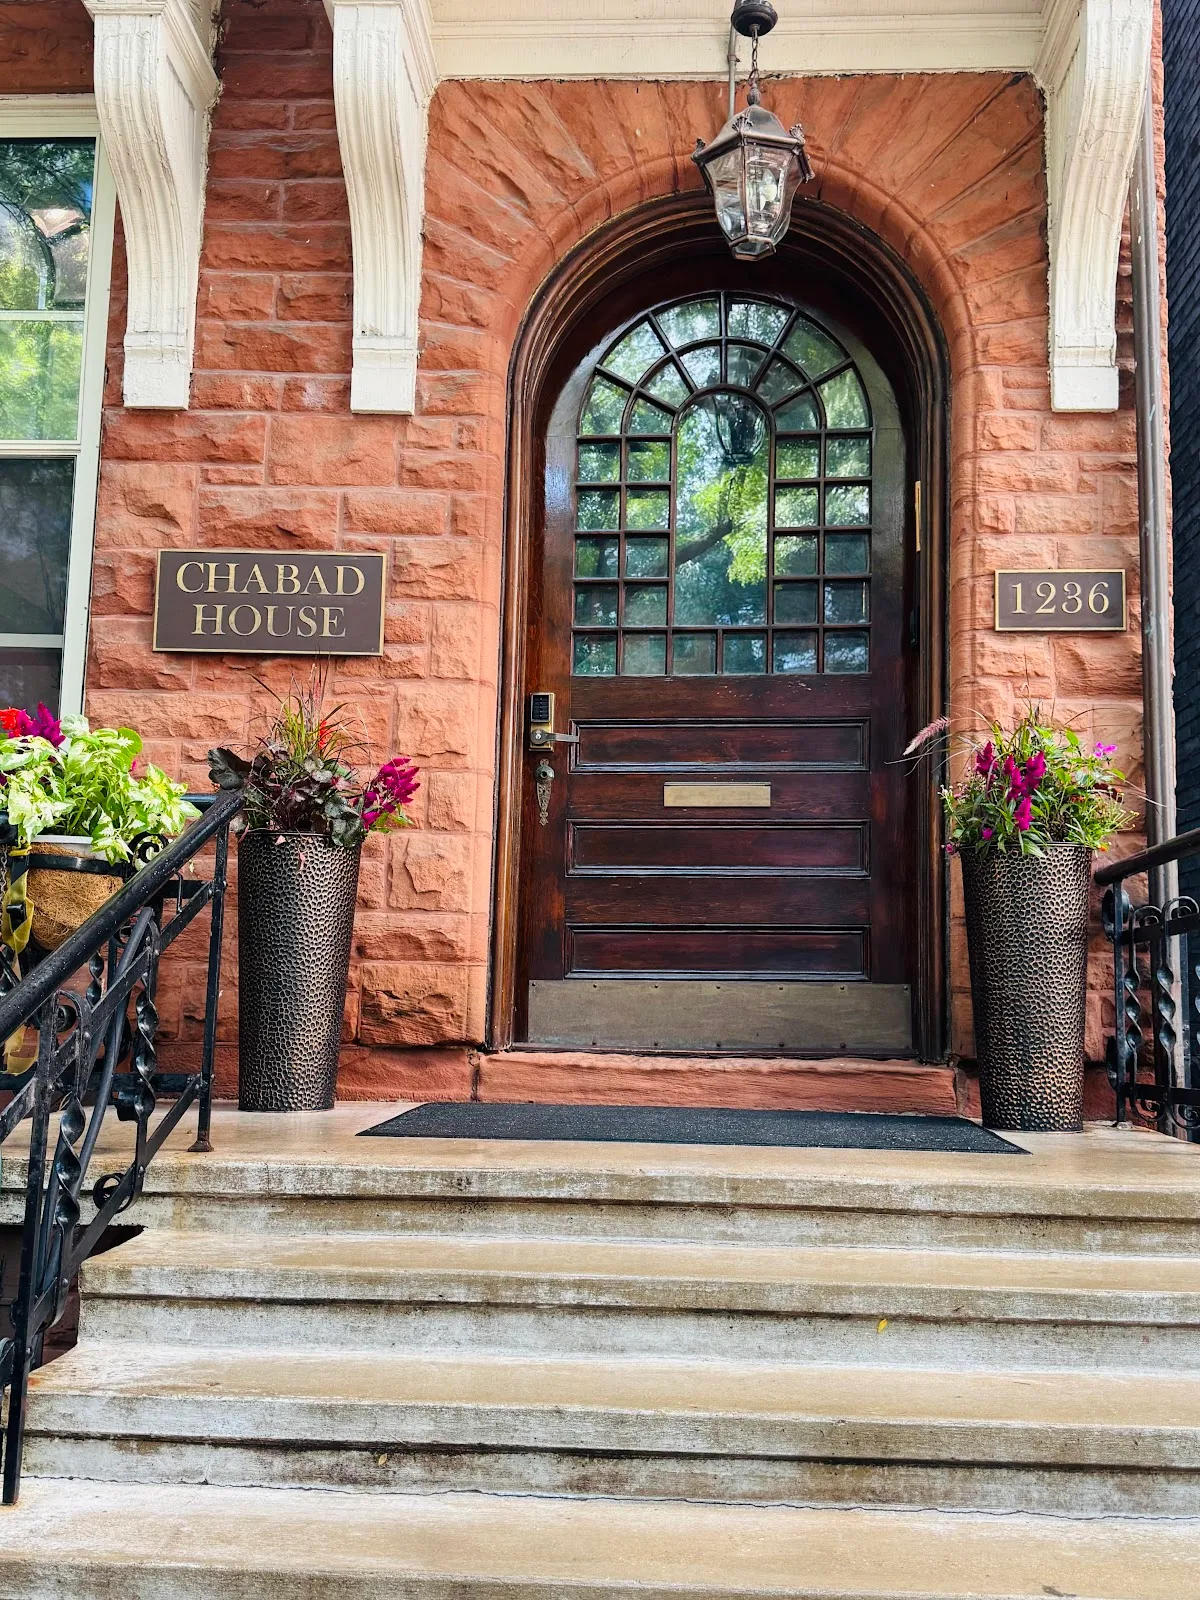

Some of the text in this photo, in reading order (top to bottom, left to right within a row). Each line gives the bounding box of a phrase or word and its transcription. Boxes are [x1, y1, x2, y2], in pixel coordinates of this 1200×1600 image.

[176, 561, 366, 596] CHABAD
[1011, 581, 1110, 614] 1236
[191, 604, 347, 638] HOUSE
